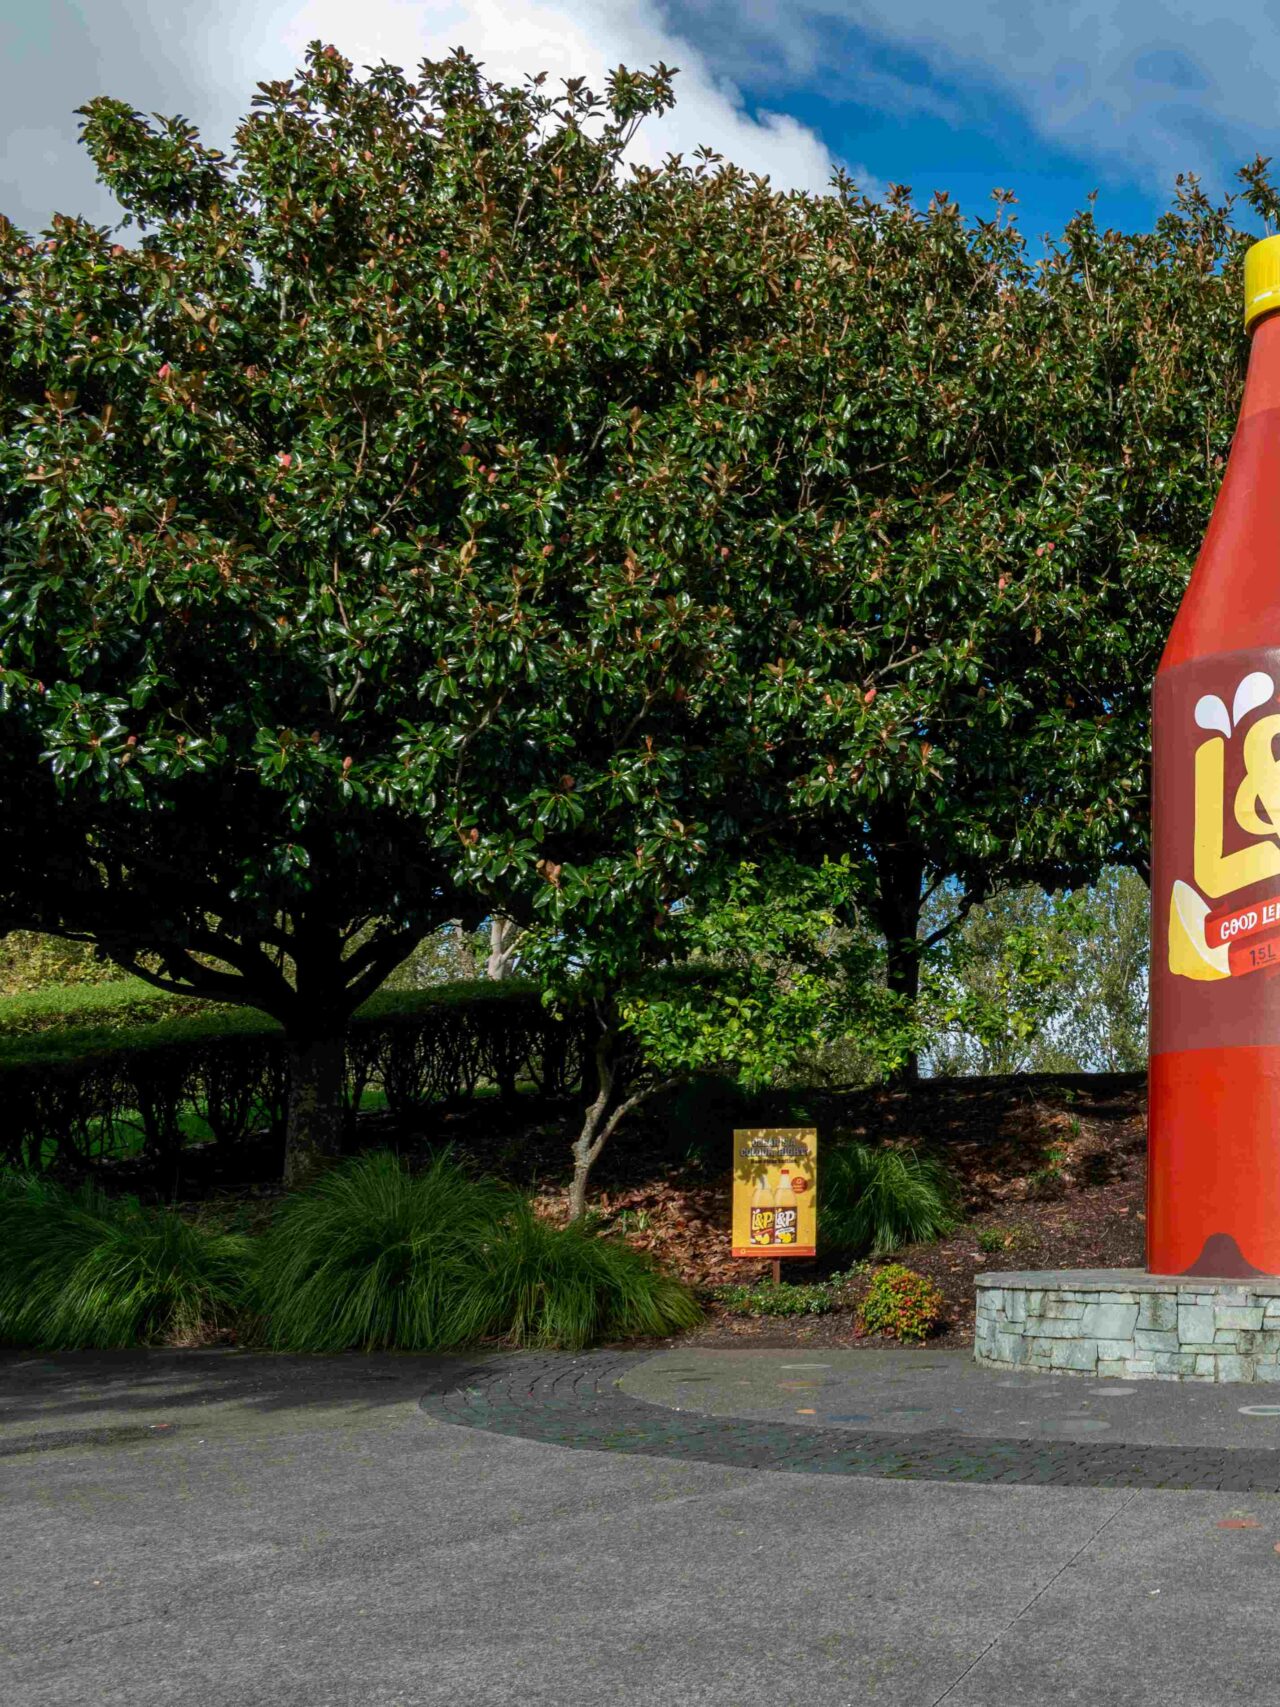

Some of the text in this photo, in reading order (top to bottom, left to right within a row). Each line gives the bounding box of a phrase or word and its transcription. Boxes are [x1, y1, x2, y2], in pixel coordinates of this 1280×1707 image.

[1220, 911, 1258, 940] GOOD
[752, 1211, 773, 1231] L&P
[775, 1210, 795, 1229] L&P
